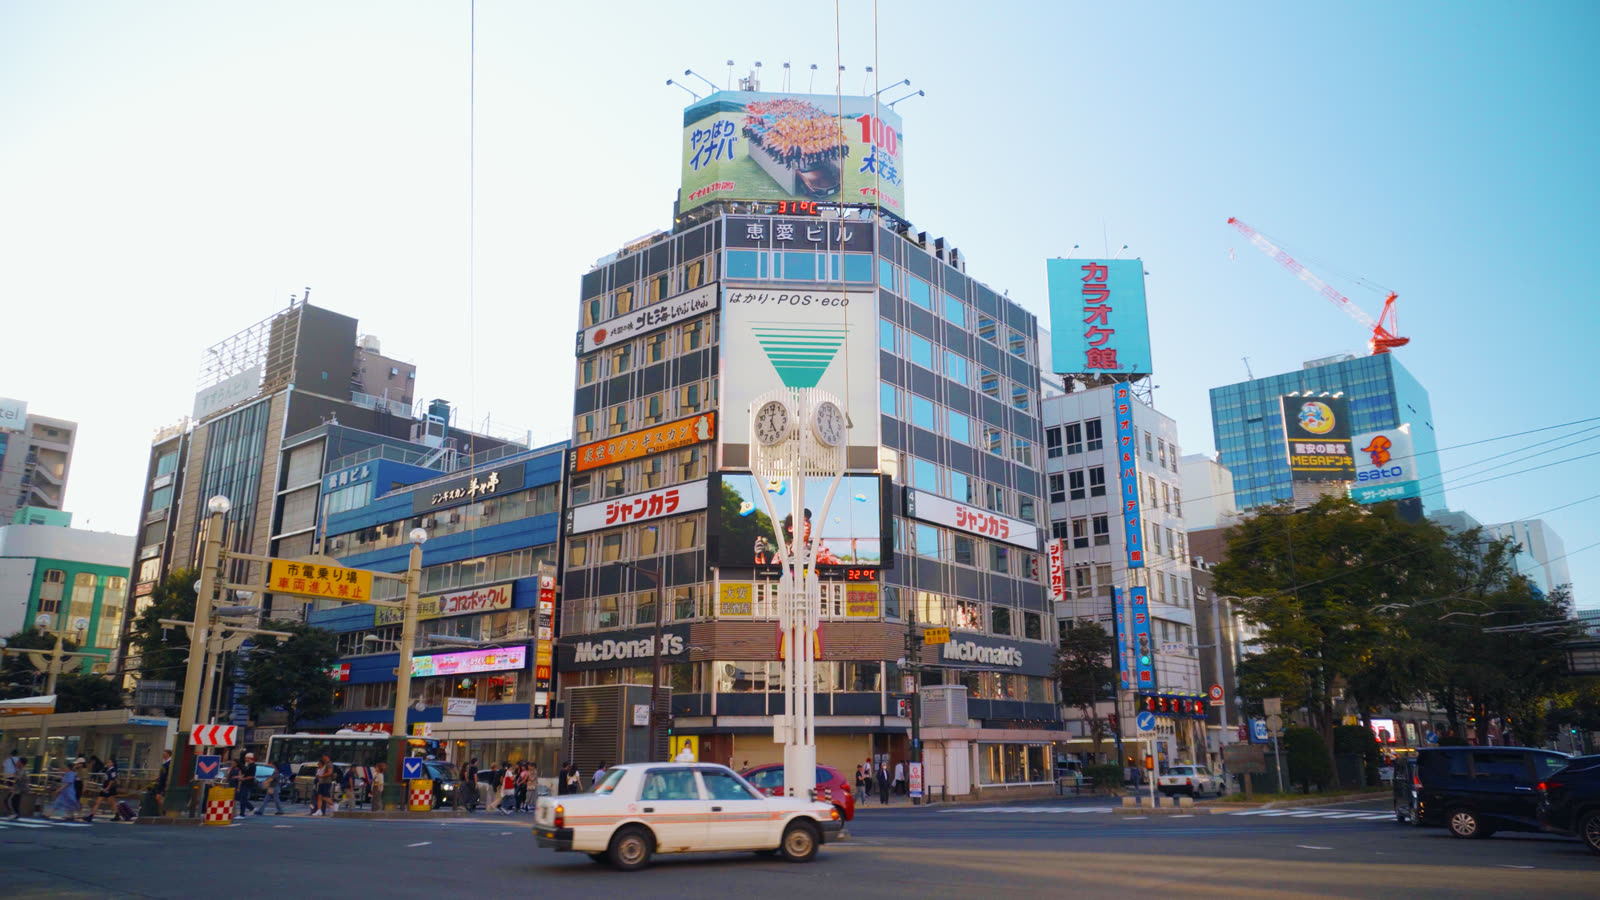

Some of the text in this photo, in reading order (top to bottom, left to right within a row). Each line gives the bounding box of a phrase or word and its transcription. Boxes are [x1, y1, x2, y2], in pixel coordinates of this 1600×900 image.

[691, 119, 735, 150] やっぱり
[689, 137, 738, 171] イナバ
[746, 223, 853, 243] 恵愛ビル
[1081, 262, 1118, 370] カラオケ館
[584, 425, 690, 464] 夜空のジンギスカン
[1292, 456, 1352, 466] MEGAドンキ
[431, 471, 499, 505] ジンギスカン 羊々亭
[1118, 388, 1142, 562] カラオケ&パーティー館
[1358, 466, 1402, 481] sato
[605, 489, 680, 525] ジャンカラ
[956, 506, 1009, 539] ジャンカラ
[287, 563, 358, 584] 市電乗り場
[1050, 544, 1062, 597] ジャンカラ
[278, 576, 363, 599] 車両進入禁止
[943, 638, 1022, 668] McDonald's
[1135, 595, 1151, 682] カラ館
